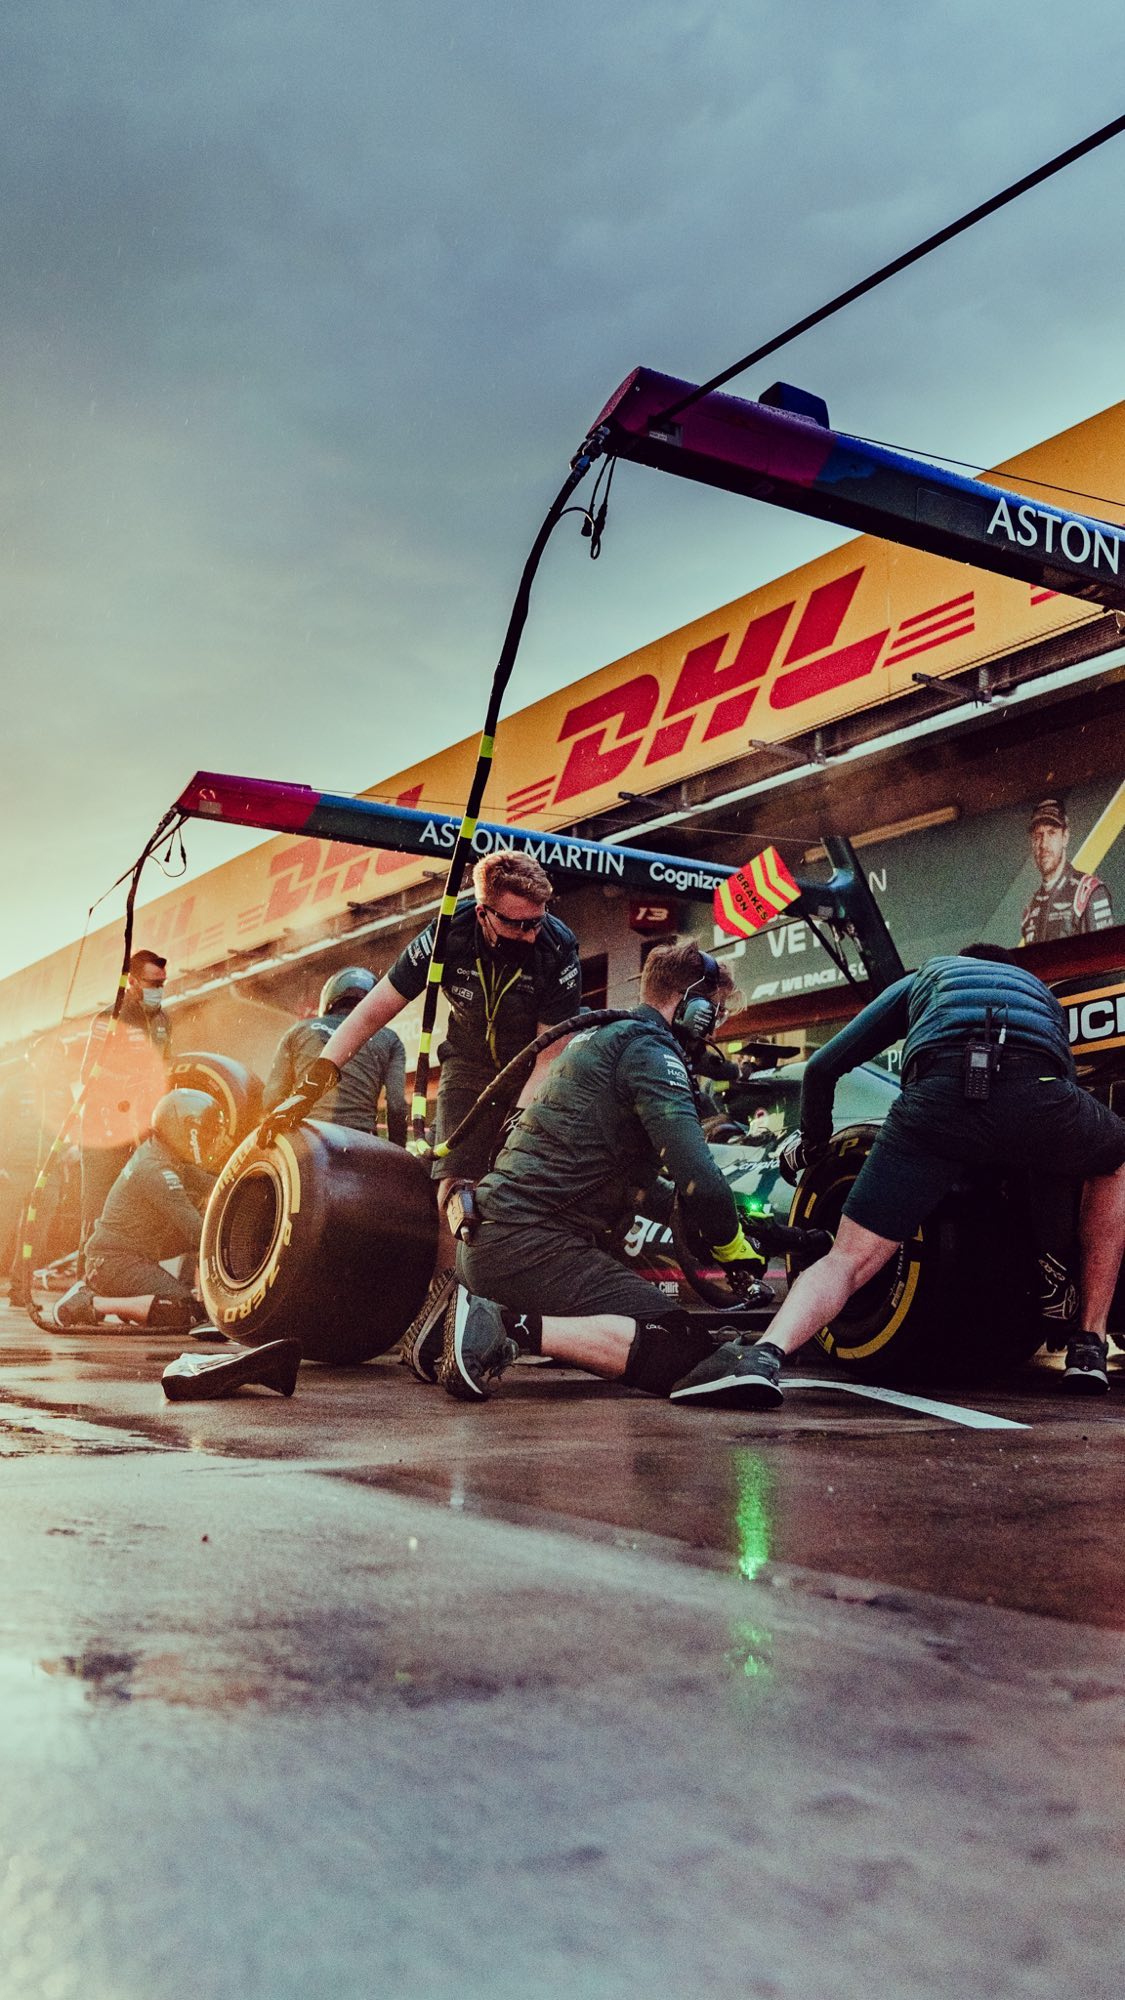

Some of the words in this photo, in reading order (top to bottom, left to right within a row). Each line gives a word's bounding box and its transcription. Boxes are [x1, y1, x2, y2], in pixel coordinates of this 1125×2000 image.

[986, 496, 1119, 575] ASTON
[551, 565, 891, 805] DHL
[523, 837, 625, 877] MARTIN
[636, 907, 669, 921] 13
[735, 893, 749, 912] ON
[736, 873, 768, 921] BRAKES
